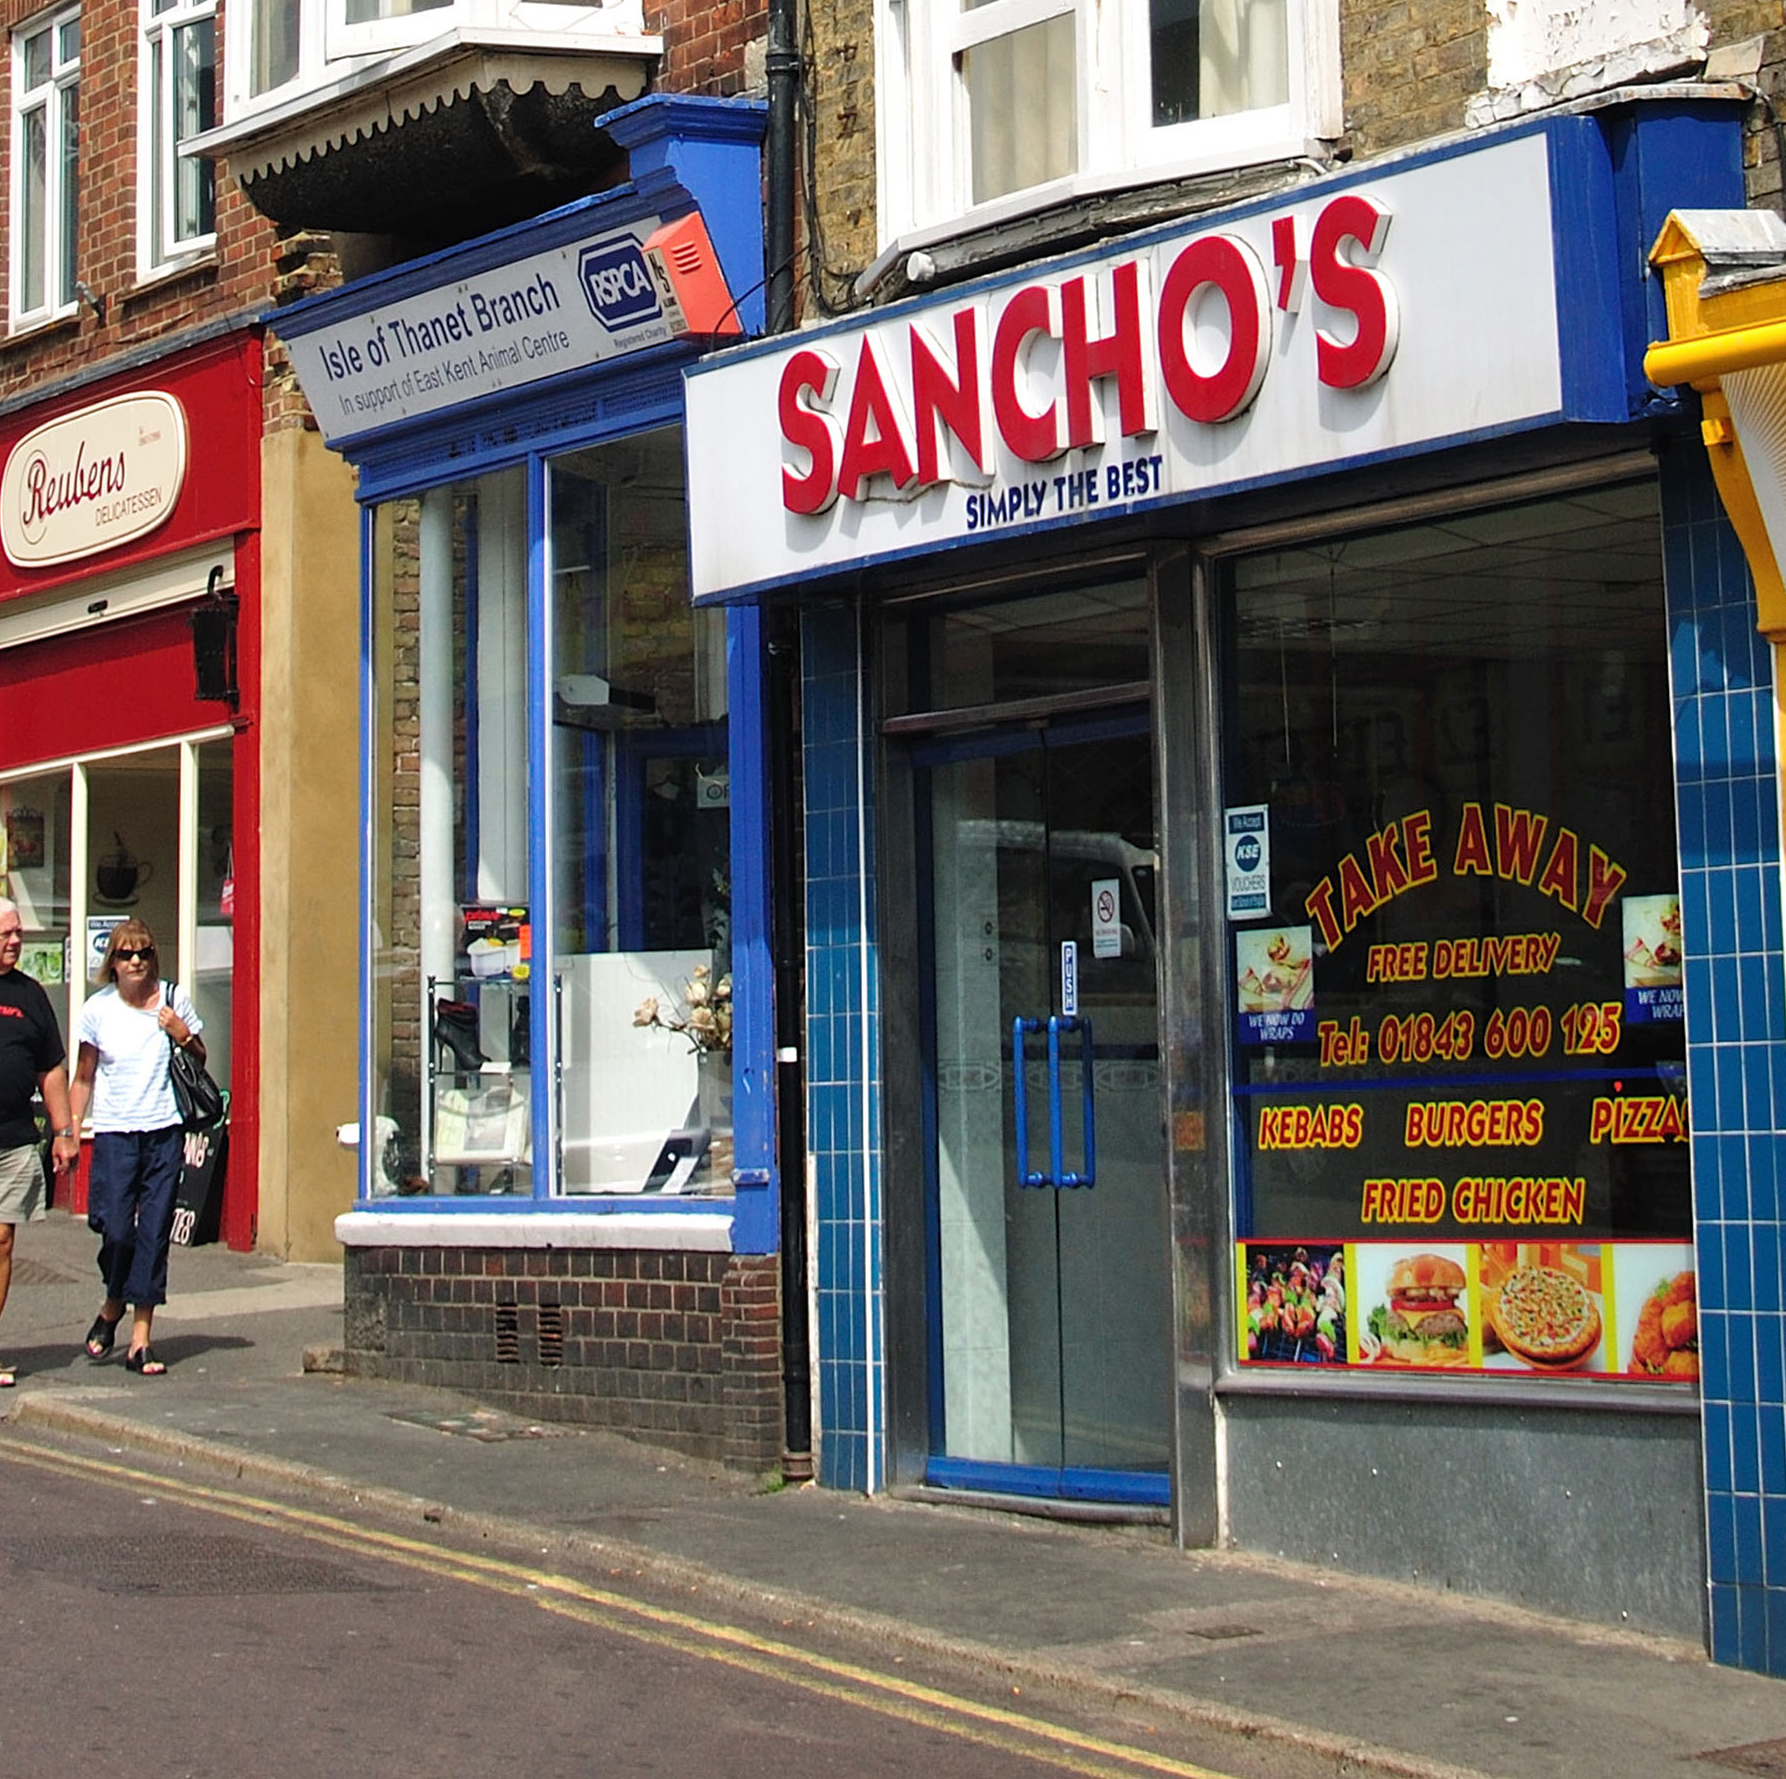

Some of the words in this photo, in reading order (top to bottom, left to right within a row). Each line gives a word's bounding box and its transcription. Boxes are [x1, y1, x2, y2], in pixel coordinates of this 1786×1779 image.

[589, 260, 652, 307] RSPCA
[320, 341, 362, 381] Isle
[367, 326, 390, 367] of
[388, 302, 473, 358] Thanet
[470, 273, 560, 331] Branch
[778, 195, 1399, 516] SANCHO'S
[339, 393, 355, 416] In
[356, 380, 400, 412] support
[402, 372, 414, 397] of
[415, 369, 443, 392] East
[443, 356, 475, 383] Kent
[479, 339, 522, 373] Animal
[522, 331, 570, 360] Centre
[23, 441, 125, 525] Reubens
[95, 486, 162, 527] DELICATESSEN
[966, 482, 1047, 531] SIMPLY
[1053, 469, 1100, 511] THE
[1106, 454, 1163, 498] BEST
[1236, 844, 1260, 859] KSE
[1305, 809, 1438, 953] TAKE
[1453, 802, 1627, 930] AWAY
[1366, 941, 1428, 983] FREE
[1432, 932, 1561, 980] DELIVERY
[1260, 1026, 1294, 1040] WRAPS
[1318, 1015, 1369, 1068] Tel:
[1377, 1009, 1475, 1064] 01843
[1484, 1005, 1552, 1059] 600
[1561, 1002, 1623, 1055] 125
[1258, 1103, 1363, 1150] KEBABS
[1405, 1098, 1544, 1148] BURGERS
[1361, 1177, 1446, 1225] FRIED
[1452, 1175, 1585, 1226] CHICKEN
